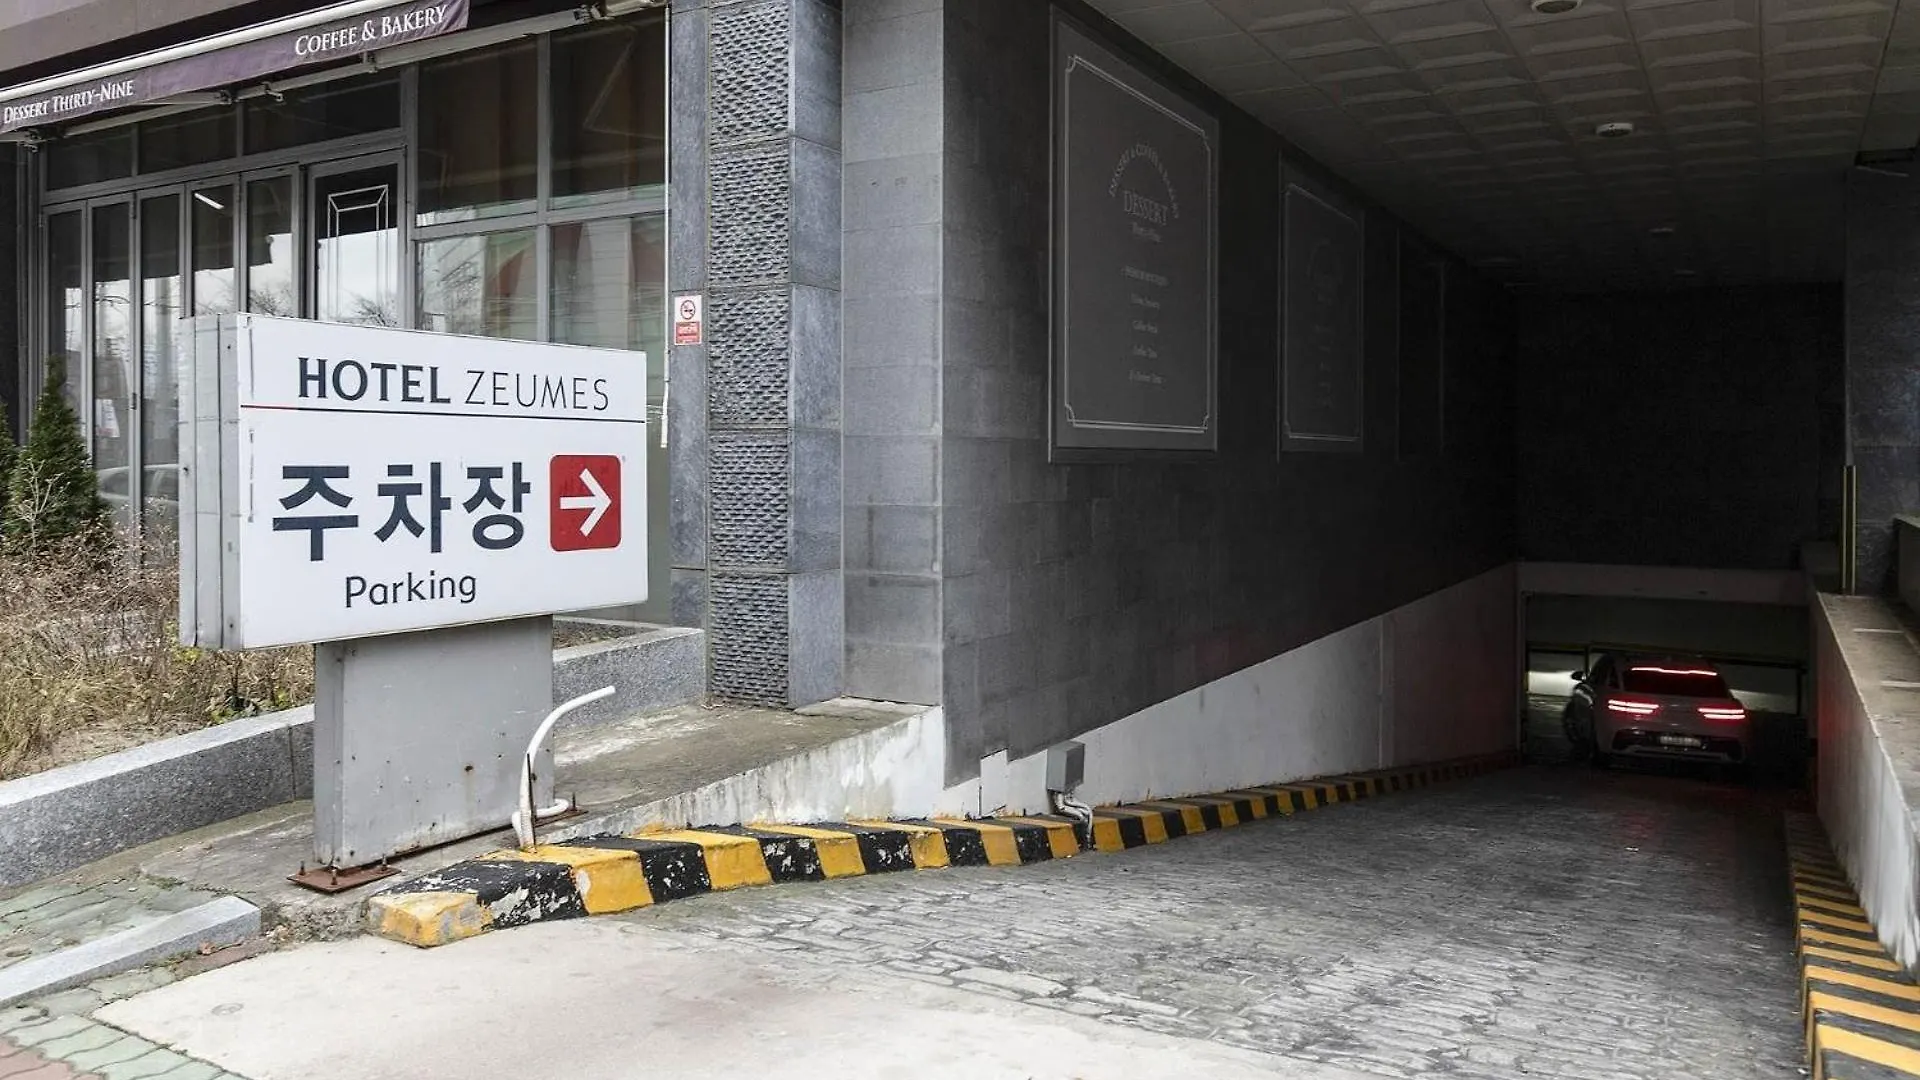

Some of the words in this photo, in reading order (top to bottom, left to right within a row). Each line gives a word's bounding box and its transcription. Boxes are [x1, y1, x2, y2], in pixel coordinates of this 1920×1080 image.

[295, 26, 357, 56] COFFEE
[361, 20, 375, 41] &
[381, 5, 447, 37] BAKERY
[4, 100, 50, 124] DESSERT
[52, 80, 135, 113] THIRTY-NINE
[298, 357, 451, 403] HOTEL
[465, 369, 609, 411] ZEUMES
[273, 462, 530, 561] 주차장
[346, 570, 476, 608] Parking
